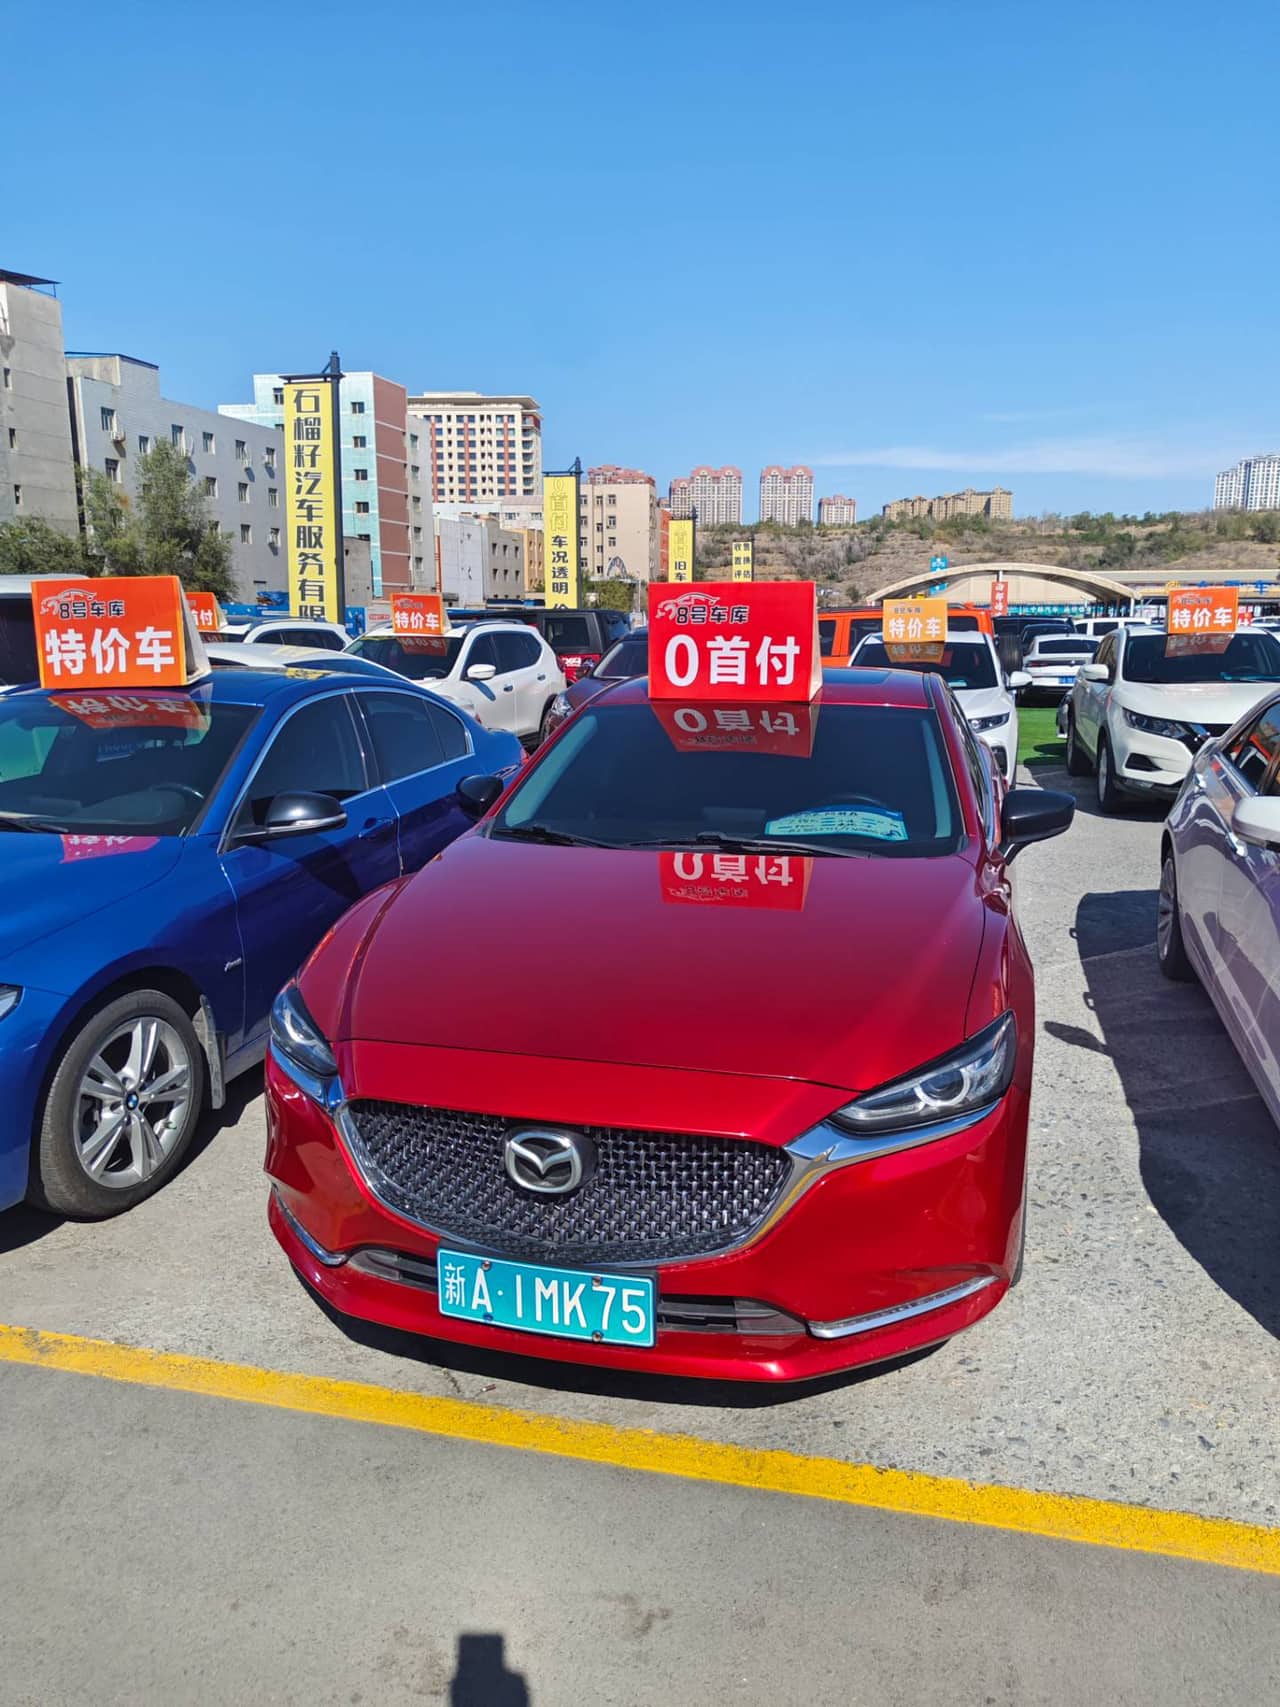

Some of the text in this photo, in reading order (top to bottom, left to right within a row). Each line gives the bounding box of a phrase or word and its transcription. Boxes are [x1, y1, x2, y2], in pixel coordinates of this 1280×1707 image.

[59, 600, 125, 619] 8号车库
[394, 611, 440, 630] 特价车
[676, 606, 749, 625] 8号车库
[1172, 607, 1233, 629] 特价车
[889, 616, 942, 639] 特价车
[45, 626, 175, 676] 特价车
[664, 634, 800, 687] 0首付
